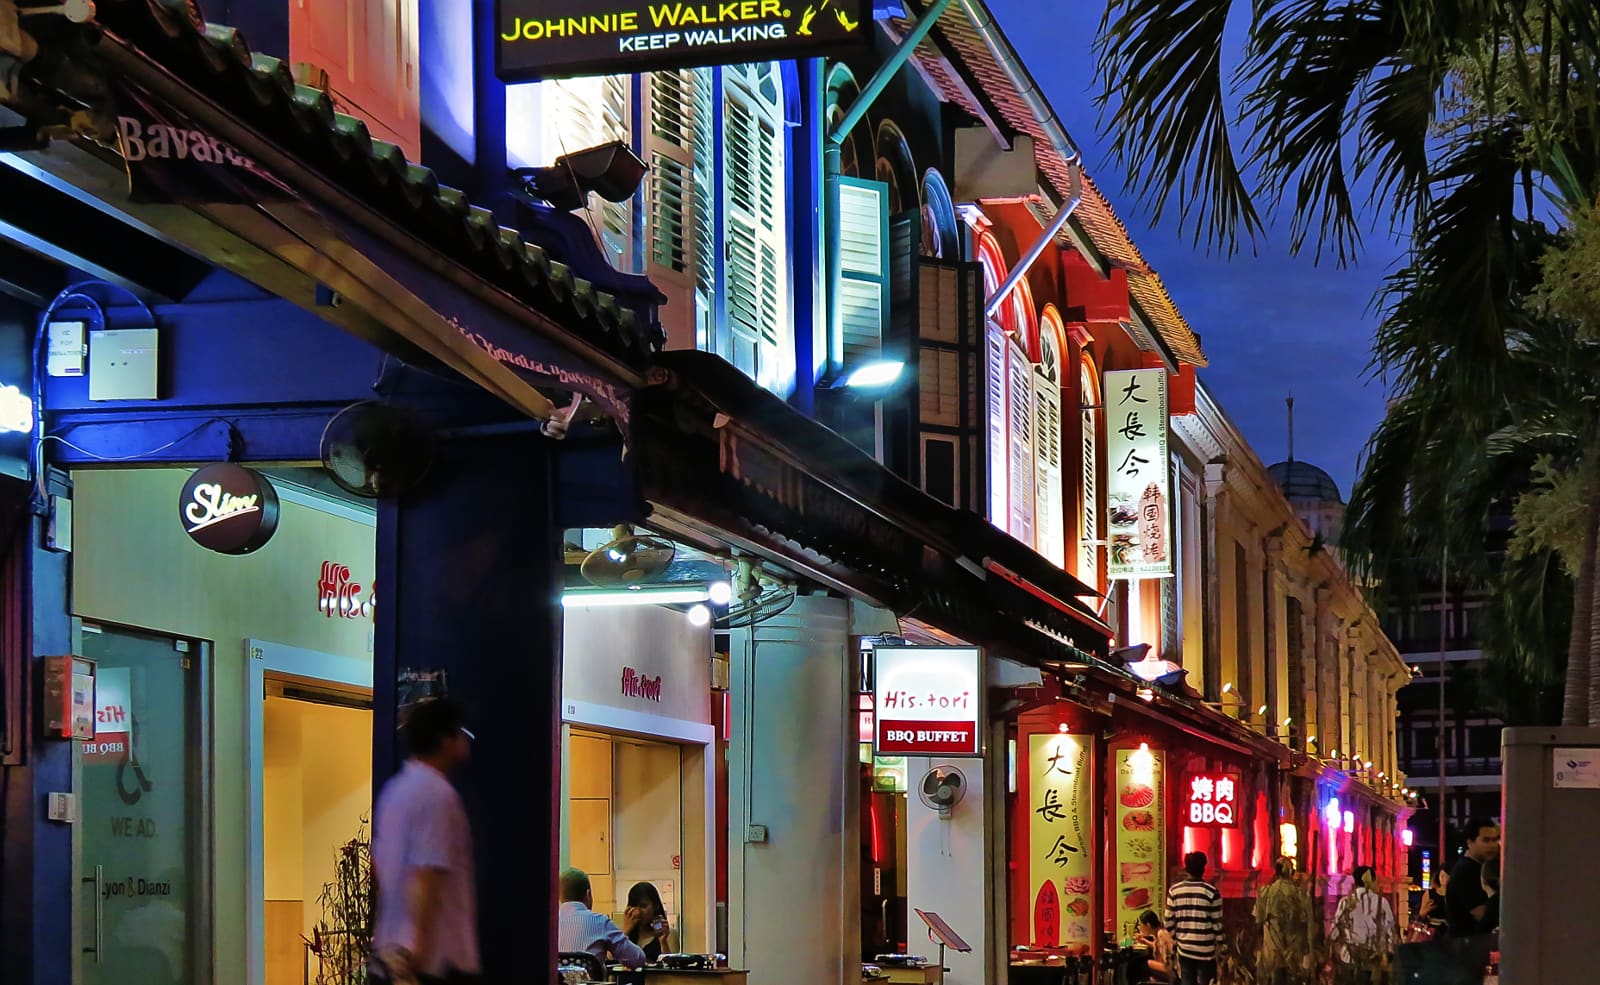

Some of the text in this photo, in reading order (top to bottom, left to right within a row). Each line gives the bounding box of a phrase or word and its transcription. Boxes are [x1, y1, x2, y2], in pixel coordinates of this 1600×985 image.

[501, 12, 638, 42] JOHNNIE
[619, 34, 680, 53] KEEP
[886, 730, 969, 744] BBQ BUFFET
[1190, 802, 1233, 824] BBQ
